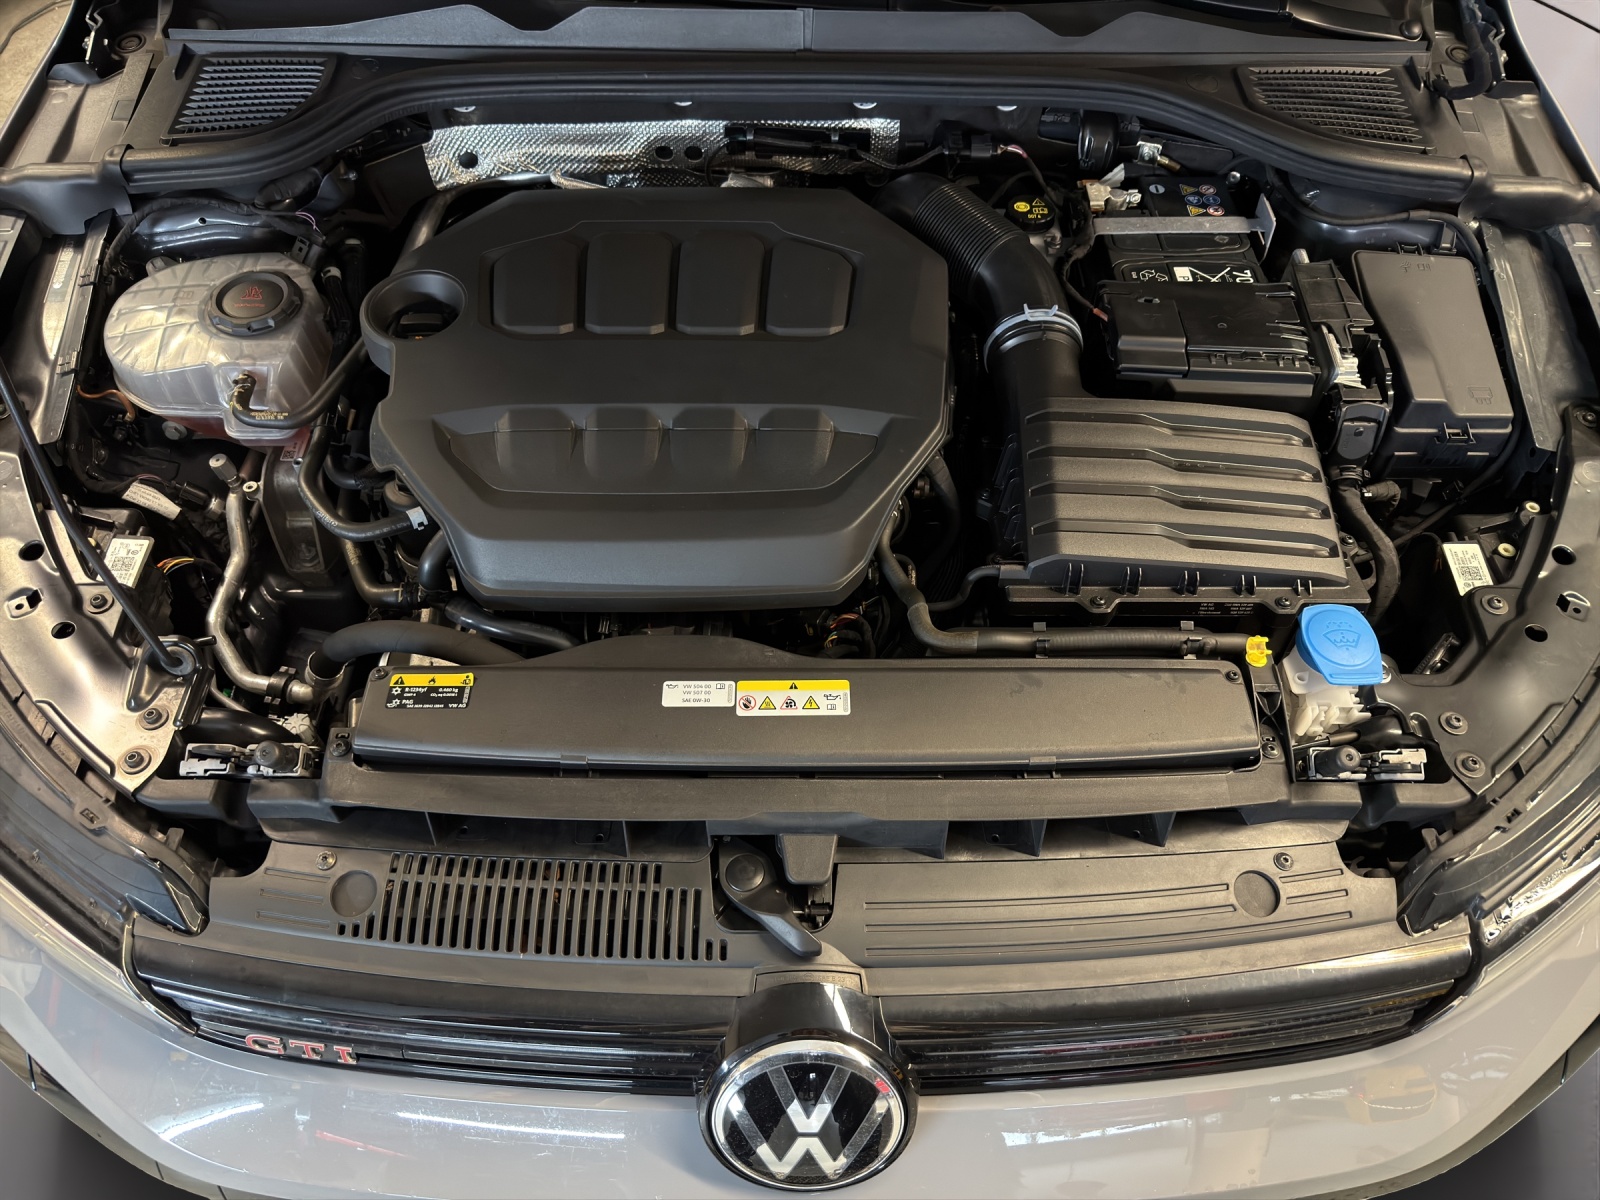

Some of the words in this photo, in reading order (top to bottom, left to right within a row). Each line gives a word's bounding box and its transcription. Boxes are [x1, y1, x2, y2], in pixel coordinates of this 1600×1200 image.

[1232, 269, 1254, 284] 70
[245, 1034, 358, 1064] GTI
[722, 1055, 896, 1182] VW
